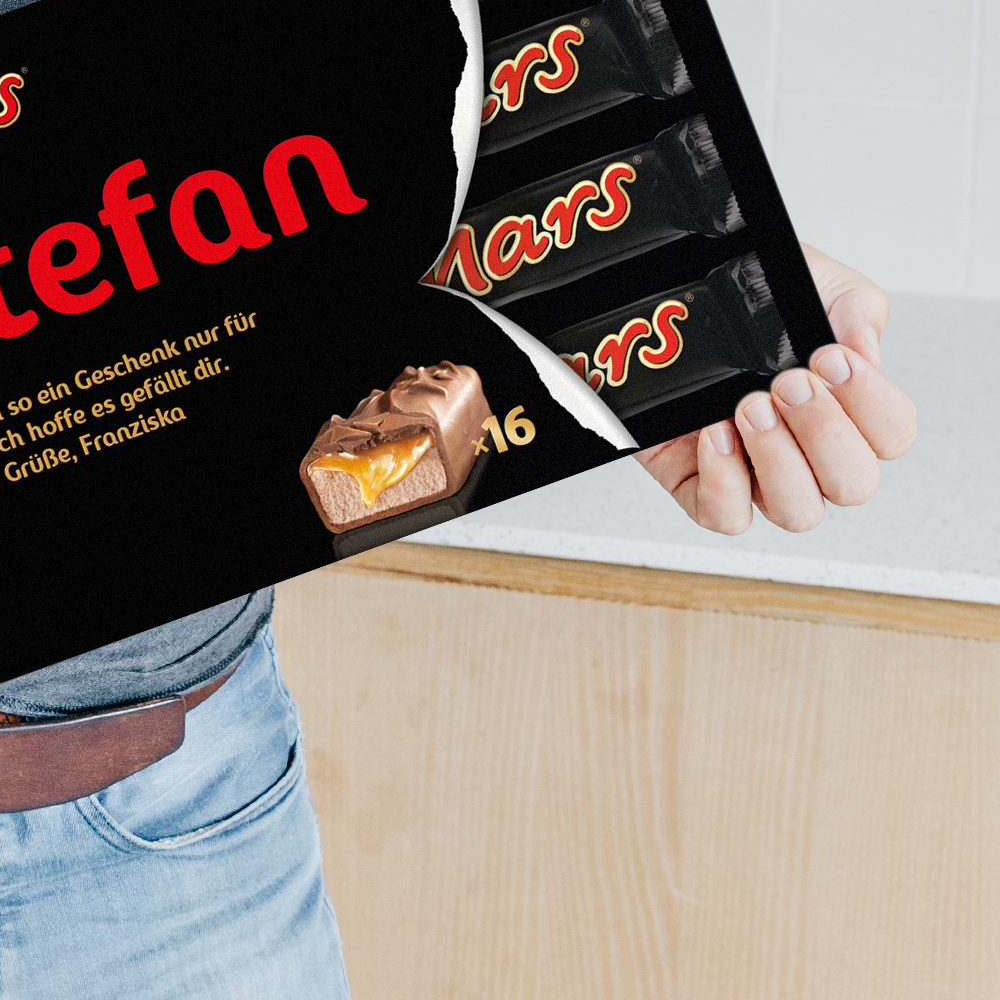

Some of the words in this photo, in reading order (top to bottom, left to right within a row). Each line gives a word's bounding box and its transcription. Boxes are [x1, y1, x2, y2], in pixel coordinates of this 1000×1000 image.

[7, 396, 33, 416] so
[37, 381, 73, 405] ein
[74, 339, 182, 390] Geschenk
[183, 325, 219, 352] nur
[223, 311, 257, 337] für
[26, 407, 87, 442] hoffe
[91, 398, 116, 418] es
[120, 367, 191, 412] gefällt
[193, 356, 231, 382] dir.
[4, 447, 79, 482] Grüße,
[78, 406, 188, 456] Franziska
